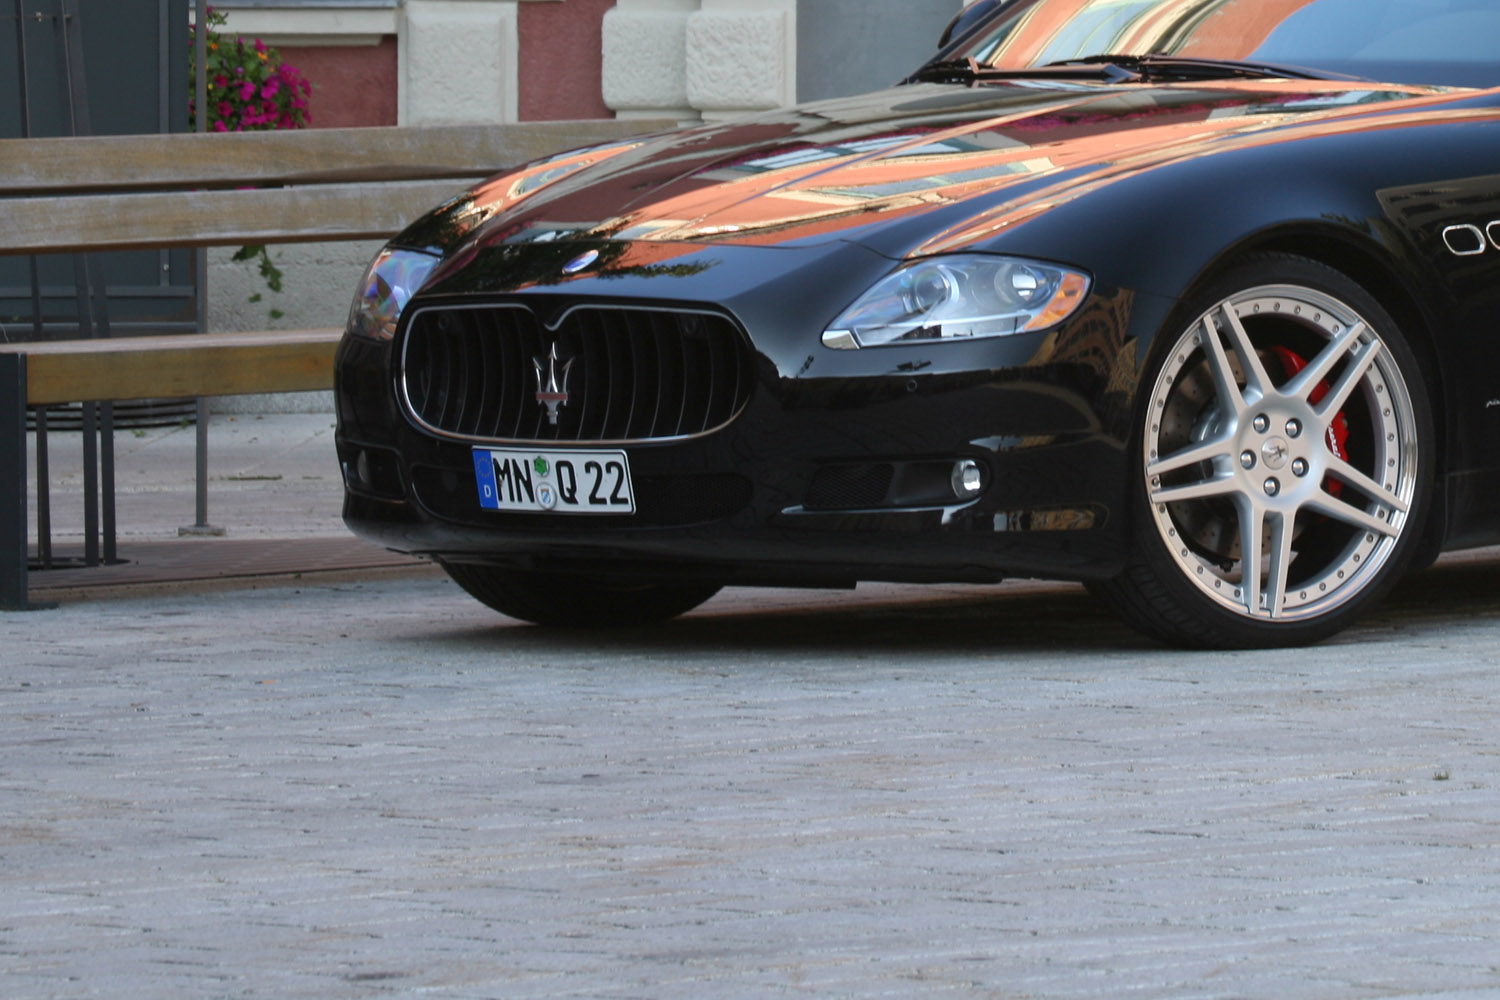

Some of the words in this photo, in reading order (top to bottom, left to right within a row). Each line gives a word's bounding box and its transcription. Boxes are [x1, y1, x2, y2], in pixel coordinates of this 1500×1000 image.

[483, 484, 492, 498] D
[493, 457, 535, 503] MN
[555, 460, 579, 505] Q
[584, 461, 629, 505] 22
